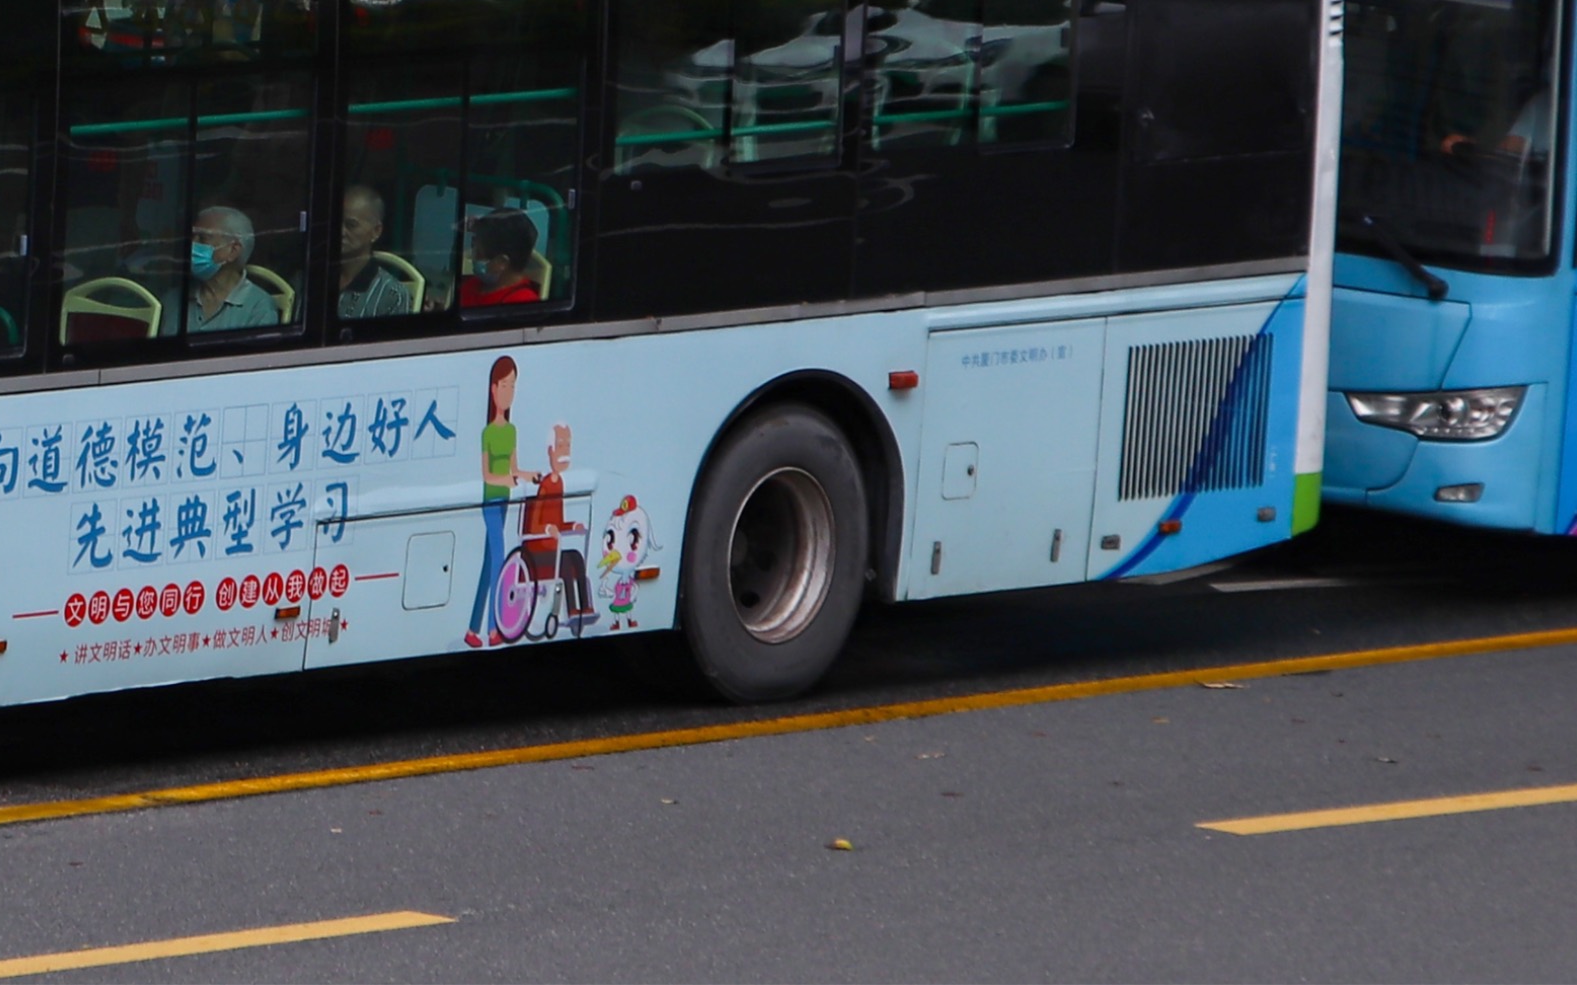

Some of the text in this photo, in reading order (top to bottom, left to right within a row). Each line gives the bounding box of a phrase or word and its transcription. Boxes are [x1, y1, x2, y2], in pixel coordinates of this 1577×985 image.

[72, 482, 350, 568] 先进典型学习
[67, 567, 347, 623] 文明与您同行 创建从我做起
